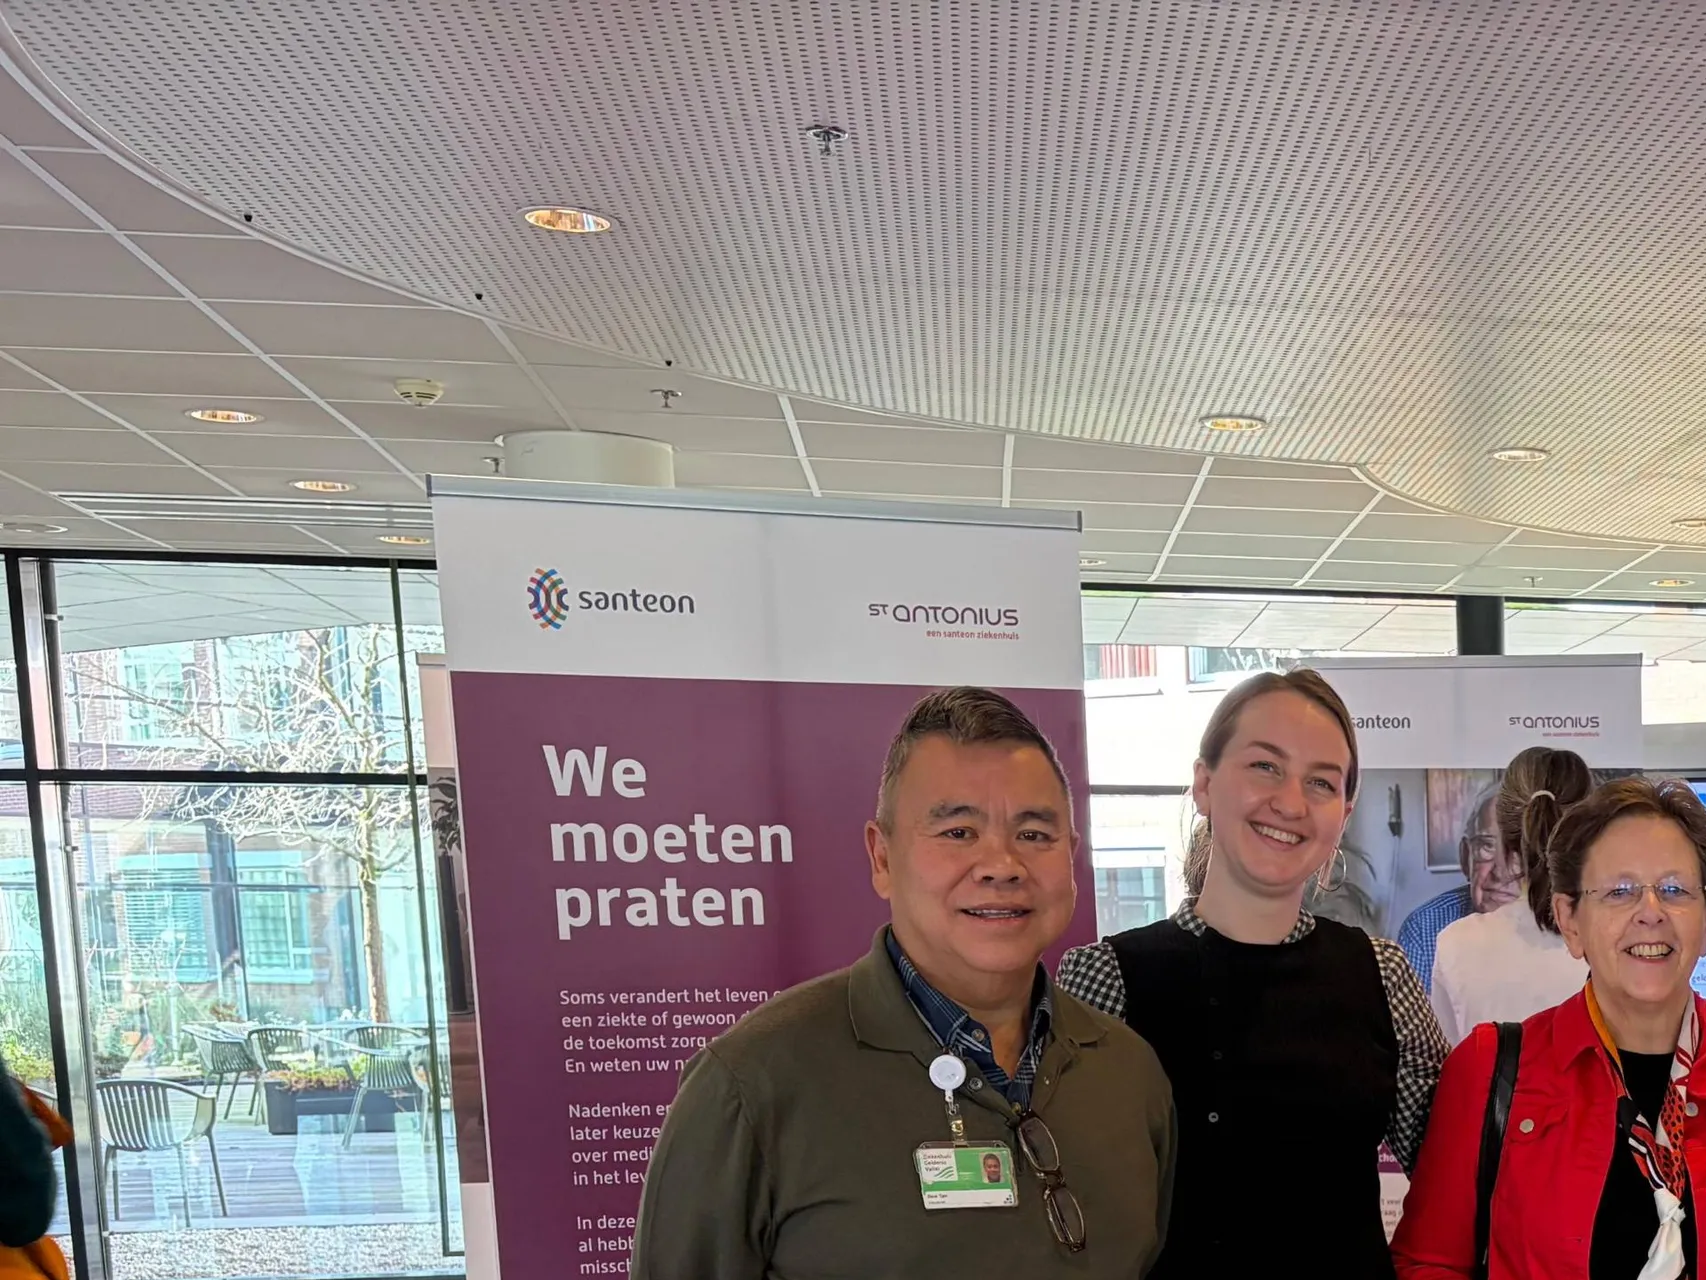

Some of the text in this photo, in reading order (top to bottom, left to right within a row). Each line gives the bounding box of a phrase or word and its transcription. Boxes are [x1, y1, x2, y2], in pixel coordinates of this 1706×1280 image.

[578, 587, 695, 615] santeon
[926, 630, 1020, 641] een santeon ziekenhuis
[543, 744, 647, 798] We
[550, 813, 793, 864] moeten
[554, 876, 765, 941] praten
[559, 990, 605, 1005] Soms
[610, 988, 690, 1005] verandert
[694, 988, 722, 1003] het
[725, 987, 769, 1003] leven
[561, 1015, 592, 1028] een
[597, 1012, 647, 1027] ziekte
[652, 1011, 668, 1027] of
[672, 1013, 736, 1029] gewoon
[563, 1035, 707, 1051] de toekomst zorg
[565, 1059, 586, 1073] En
[590, 1058, 641, 1073] weten
[646, 1059, 670, 1071] uw
[568, 1102, 651, 1118] Nadenken
[570, 1125, 609, 1141] later
[572, 1146, 653, 1163] over medi
[573, 1169, 647, 1186] in het lev
[577, 1214, 636, 1230] In deze
[578, 1237, 593, 1253] al
